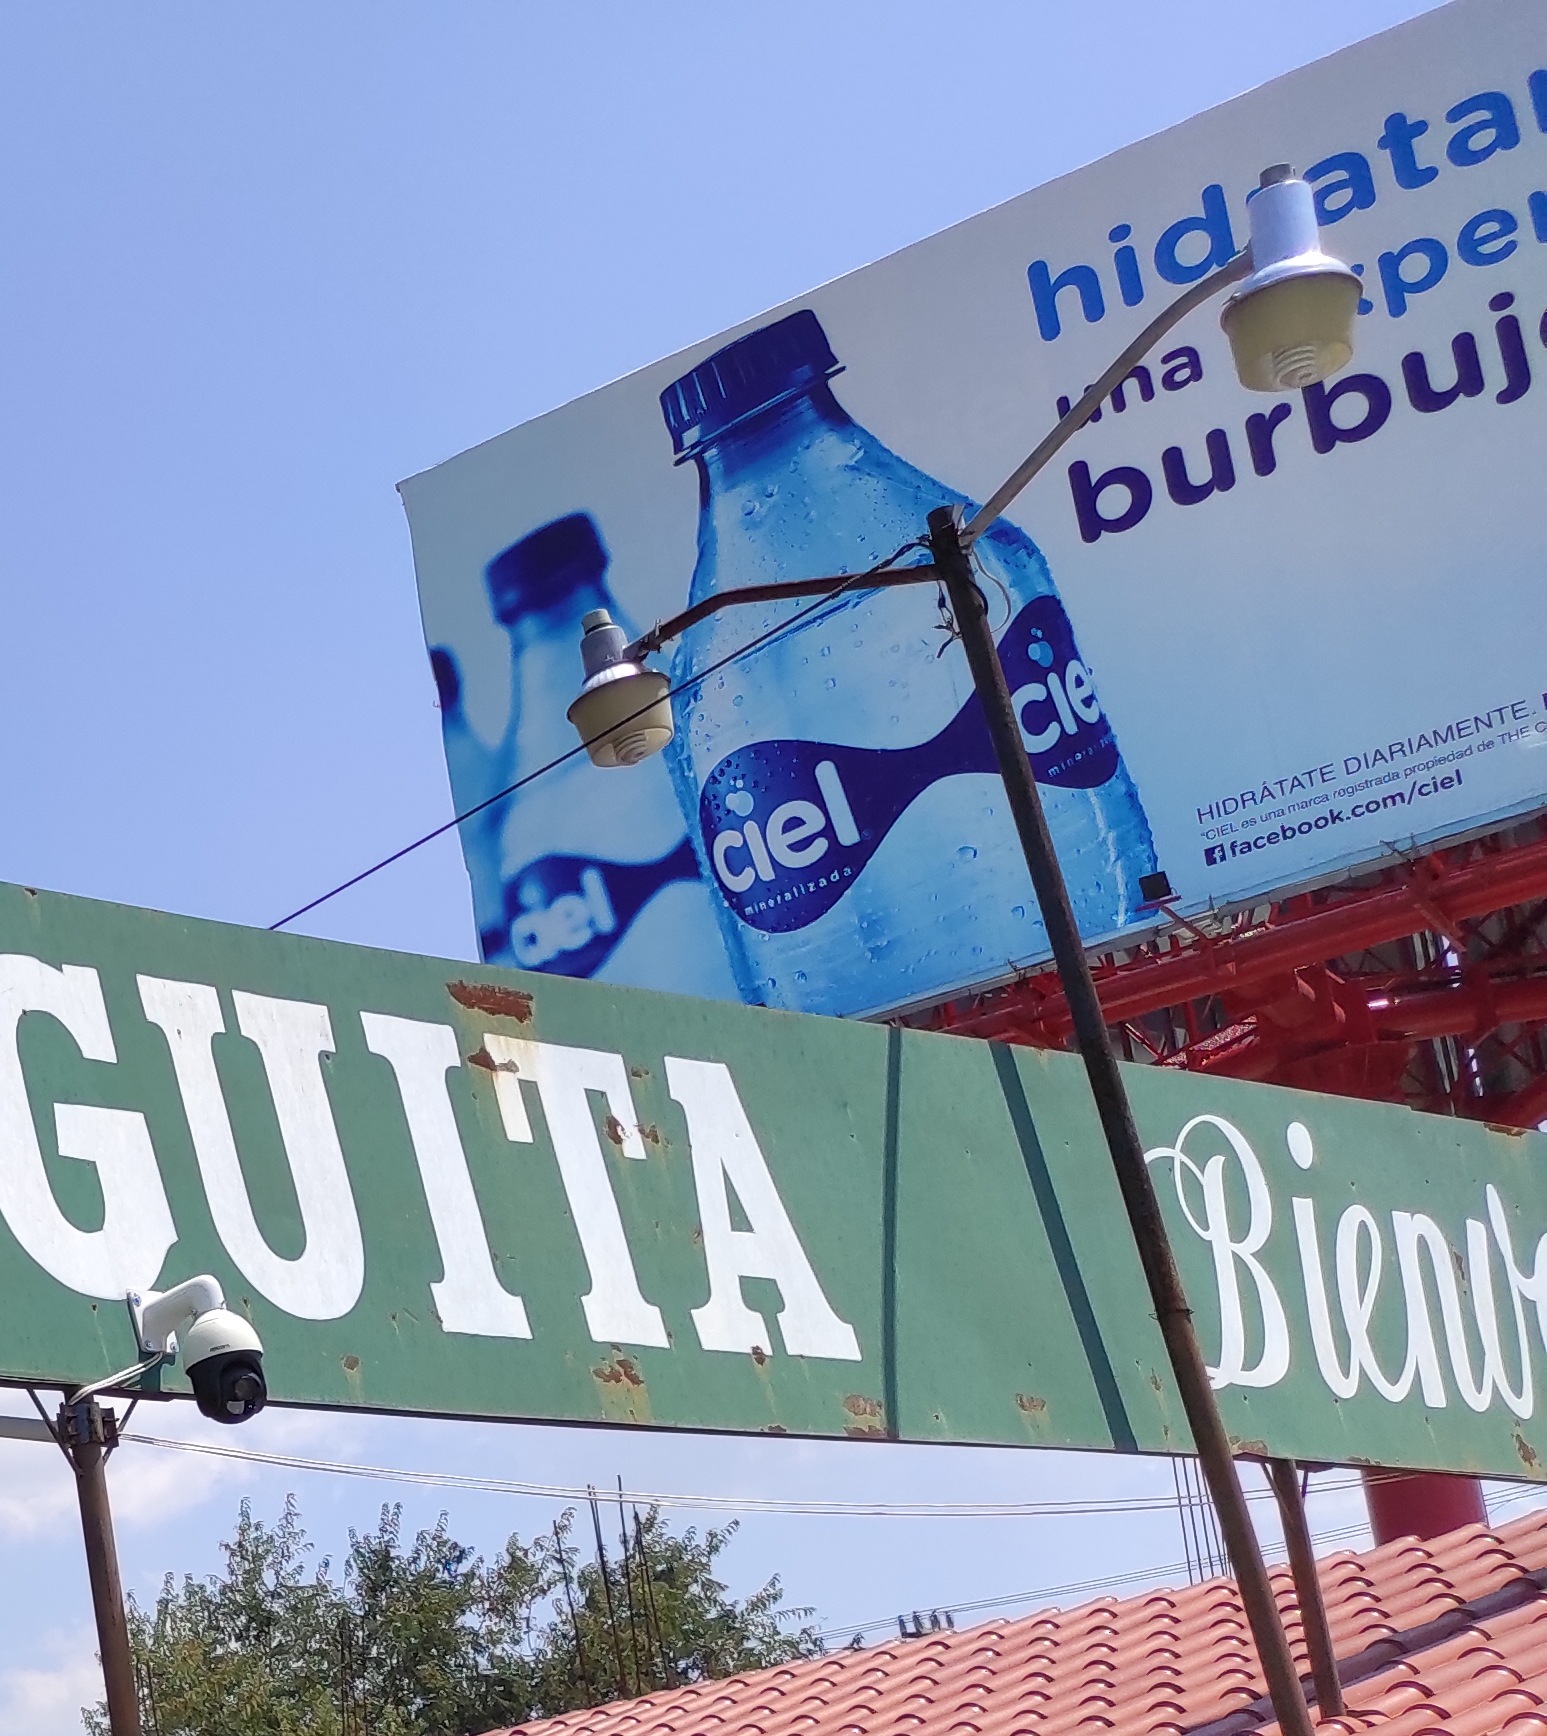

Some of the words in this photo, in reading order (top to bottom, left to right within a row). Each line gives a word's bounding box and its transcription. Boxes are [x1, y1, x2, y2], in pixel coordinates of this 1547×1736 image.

[1068, 292, 1547, 544] burbuj
[1196, 762, 1337, 825] HIDRÁTATE
[1343, 699, 1537, 776] DIARIAMENTE.
[1228, 768, 1464, 859] facebook.com/ciel
[1241, 816, 1257, 830] es
[1259, 808, 1286, 823] una
[1288, 793, 1330, 815] marca
[1332, 771, 1401, 800] registrada
[1403, 744, 1474, 780] propiedad
[1477, 740, 1495, 753] de
[1497, 725, 1531, 745] THE
[713, 759, 862, 893] ciel
[744, 866, 853, 917] mineralizada
[1144, 1113, 1547, 1420] Bienv
